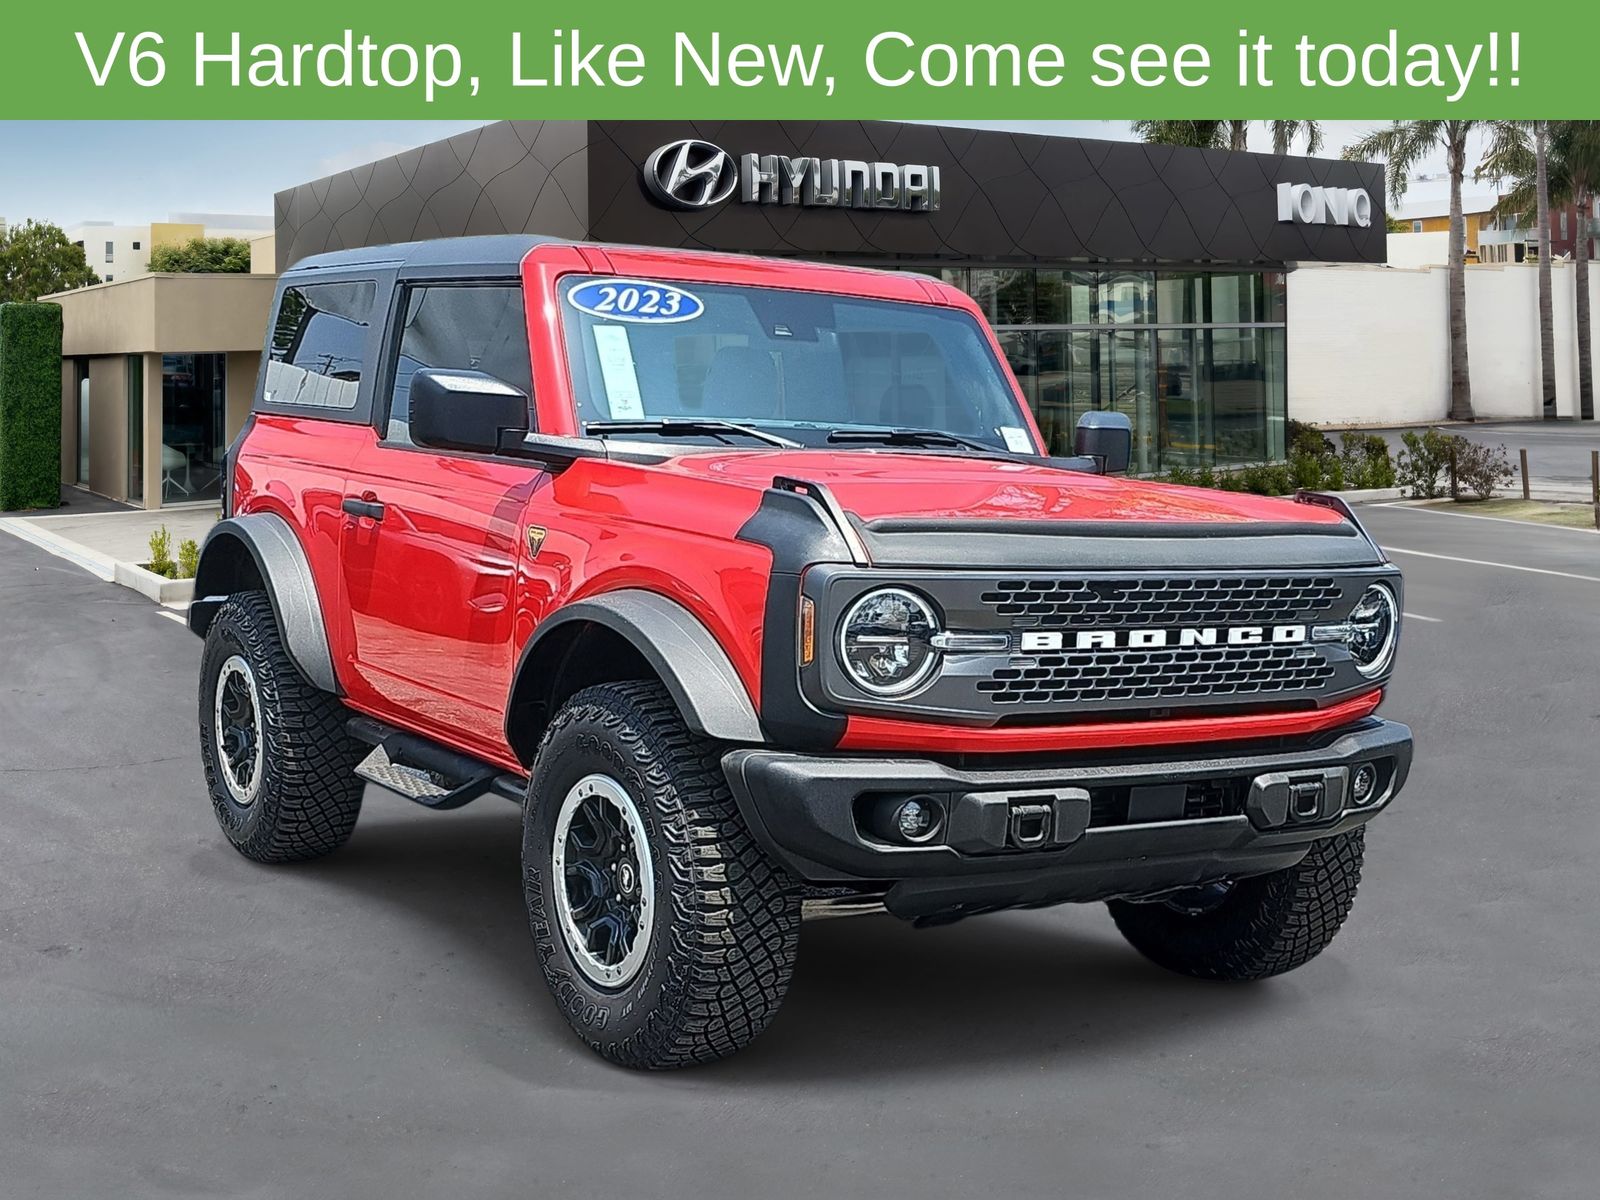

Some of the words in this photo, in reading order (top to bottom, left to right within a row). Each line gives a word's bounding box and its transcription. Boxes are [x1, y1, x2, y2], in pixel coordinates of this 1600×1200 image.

[741, 152, 941, 212] HYUNDAI
[593, 286, 682, 316] 2023
[1021, 625, 1307, 651] BRONCO
